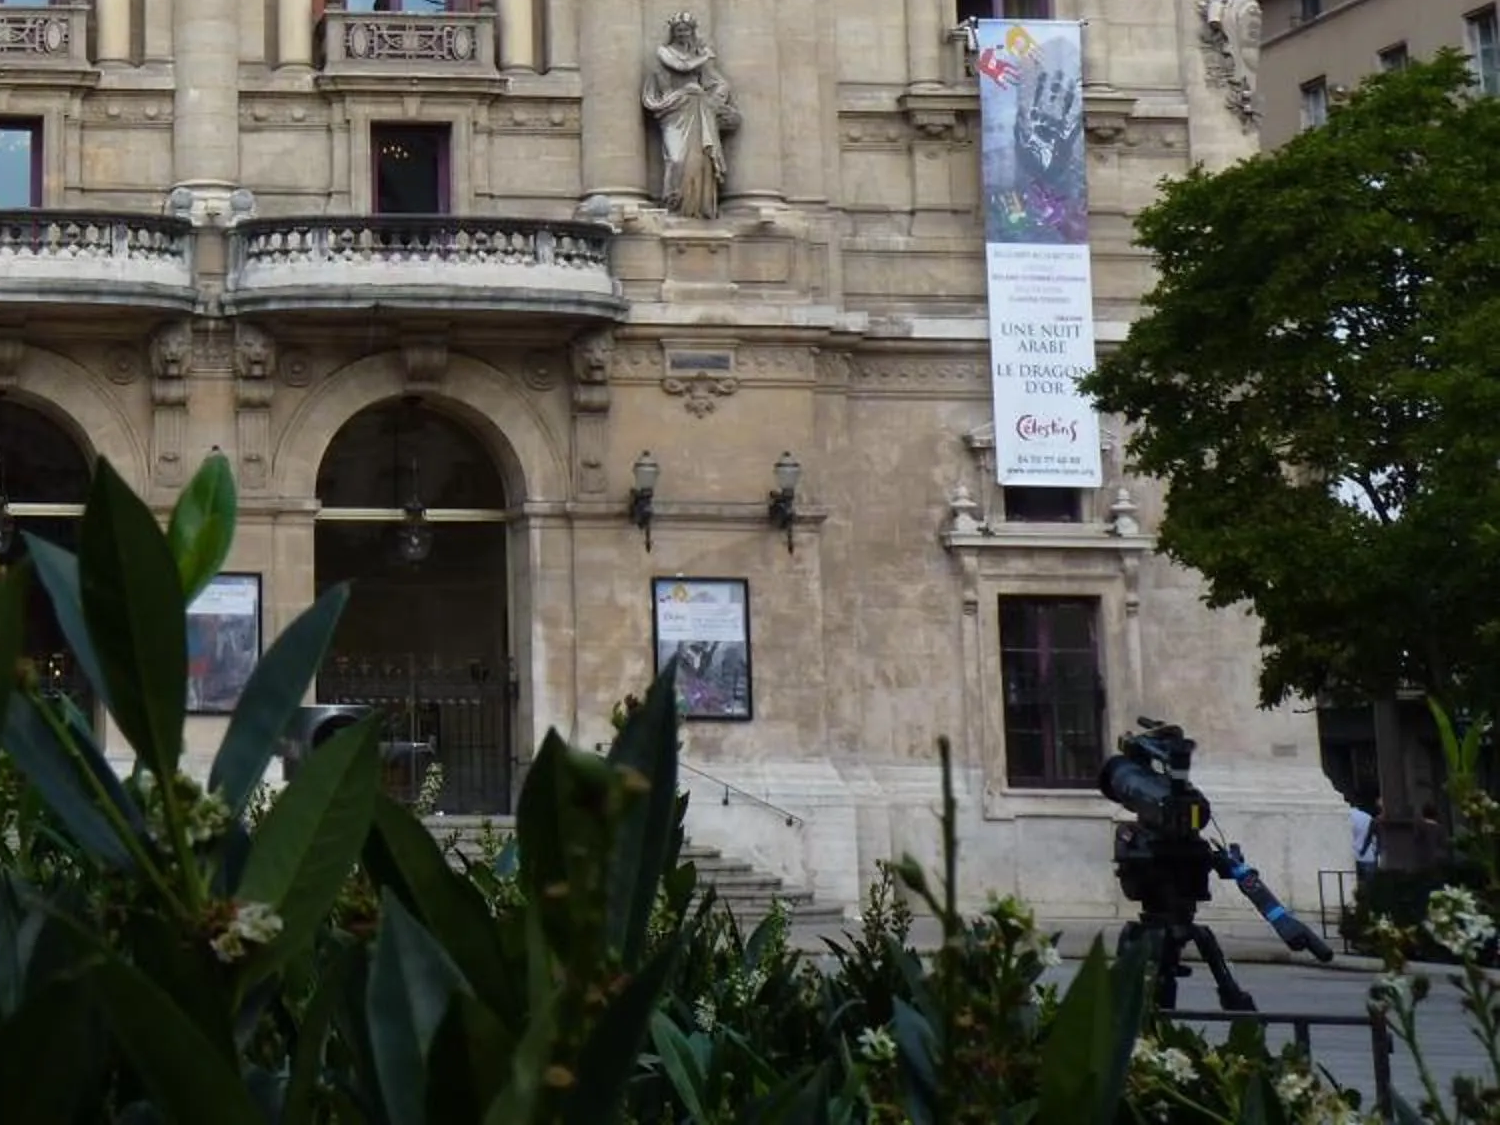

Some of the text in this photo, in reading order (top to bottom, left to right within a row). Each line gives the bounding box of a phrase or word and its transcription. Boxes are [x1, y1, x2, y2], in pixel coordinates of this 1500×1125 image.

[1001, 323, 1081, 338] UNE NUIT
[1018, 340, 1067, 354] ARABE
[997, 363, 1012, 377] LE
[1025, 381, 1065, 395] D'OR
